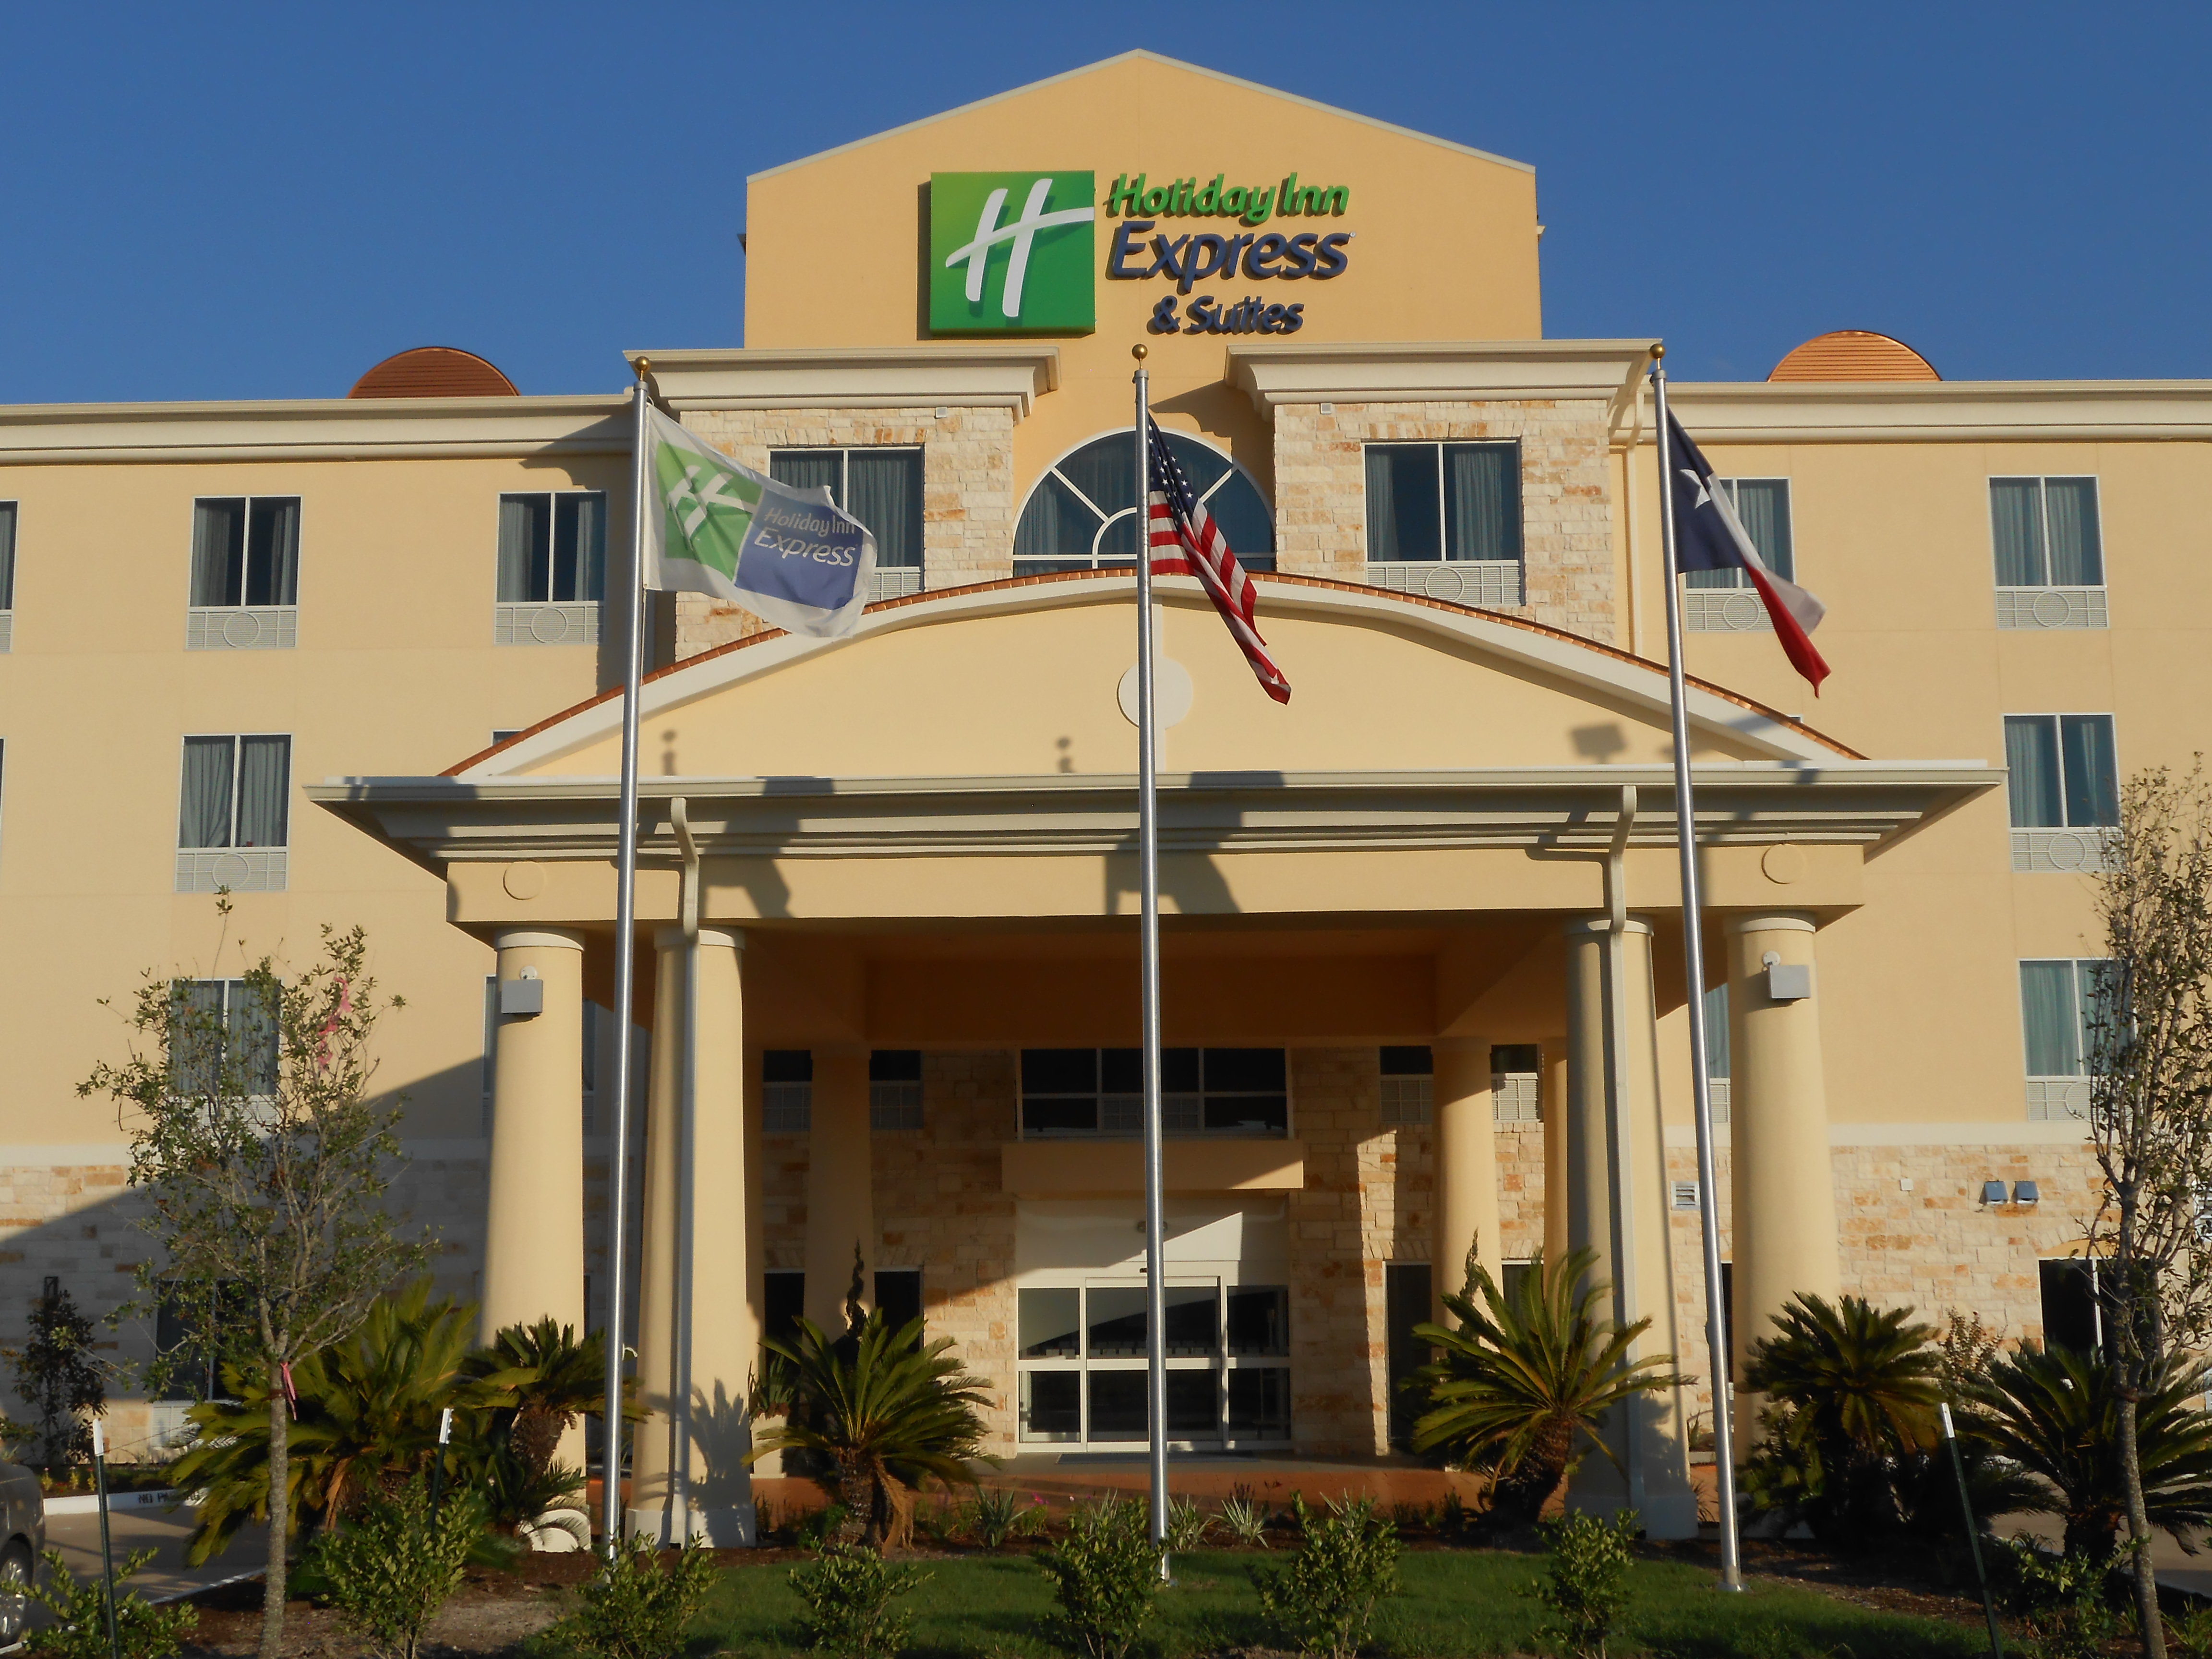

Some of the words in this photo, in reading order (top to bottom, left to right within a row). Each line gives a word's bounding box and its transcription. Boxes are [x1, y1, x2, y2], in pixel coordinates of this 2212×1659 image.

[1109, 173, 1276, 222] Holiday
[1283, 172, 1350, 212] Inn
[1112, 220, 1350, 292] Express
[1152, 295, 1181, 332] &
[1183, 295, 1305, 334] Suites
[764, 507, 830, 537] Holiday
[832, 515, 855, 534] Inn
[754, 527, 856, 567] Express
[138, 1493, 153, 1503] NO
